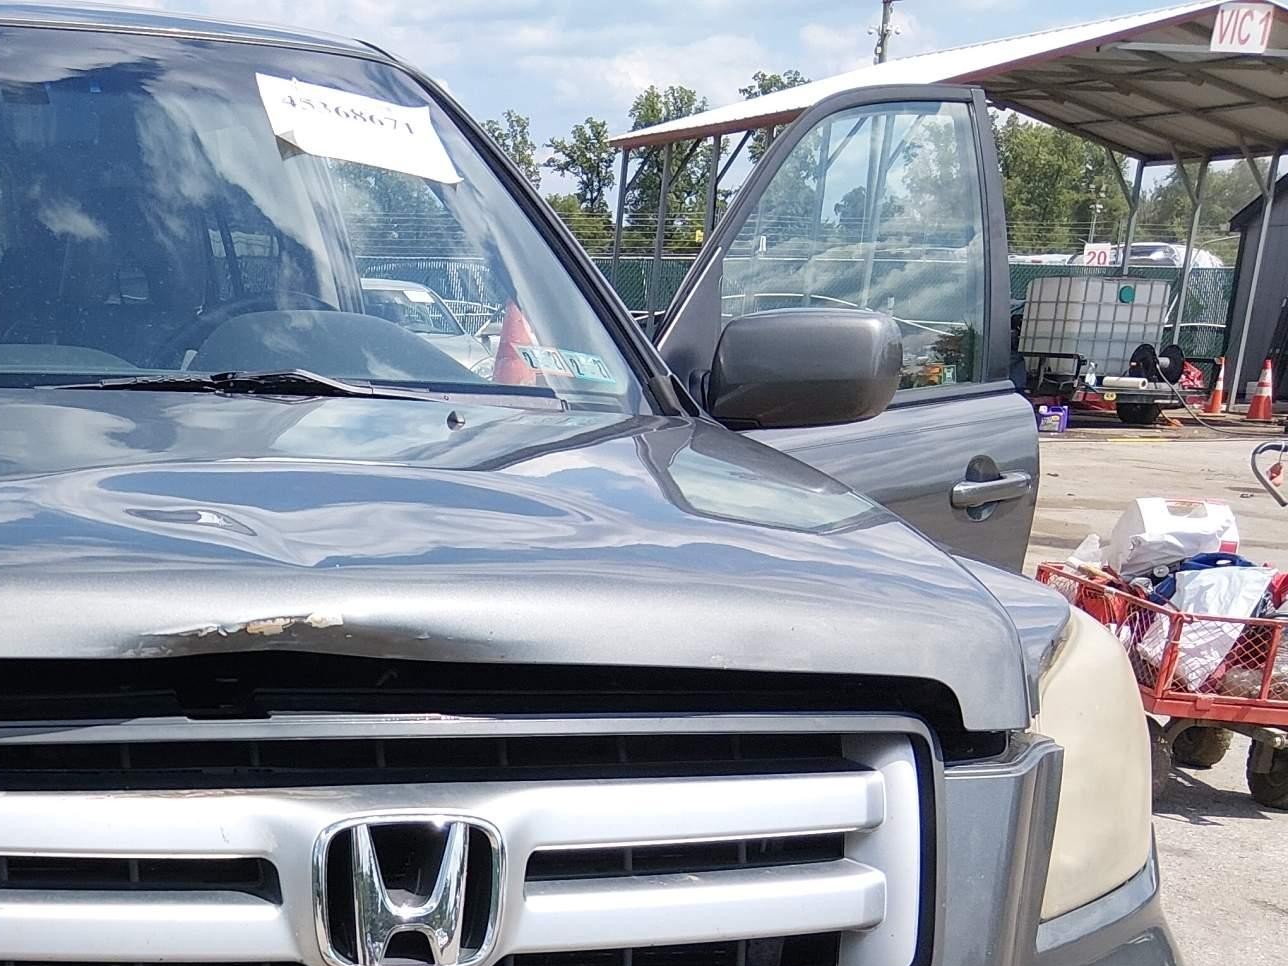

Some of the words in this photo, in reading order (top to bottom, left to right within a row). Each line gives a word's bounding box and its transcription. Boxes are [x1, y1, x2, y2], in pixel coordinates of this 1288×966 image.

[1219, 9, 1254, 45] VIC
[1259, 11, 1271, 46] 1
[282, 95, 414, 135] 45368671
[1086, 250, 1107, 265] 20
